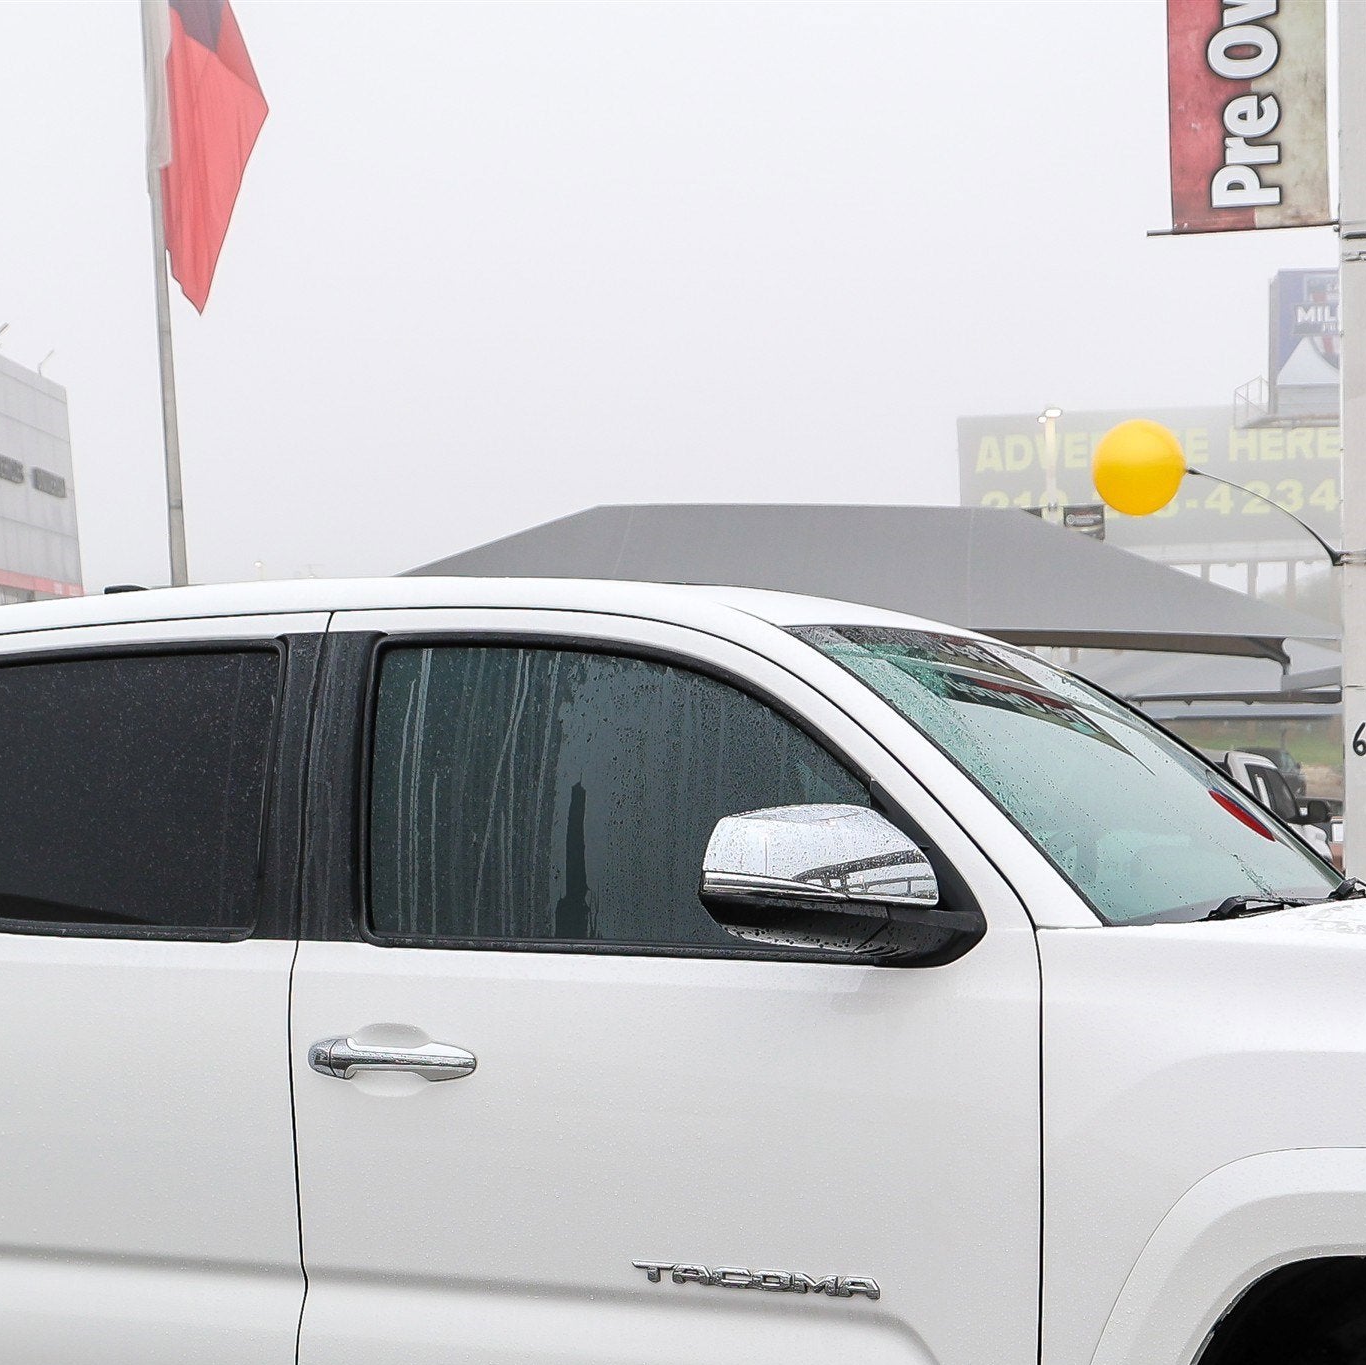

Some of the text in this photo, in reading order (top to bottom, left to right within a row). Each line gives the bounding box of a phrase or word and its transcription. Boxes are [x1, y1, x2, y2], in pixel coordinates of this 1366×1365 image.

[1211, 93, 1281, 208] Pre
[1228, 425, 1341, 462] HERE
[632, 1259, 881, 1300] TACOMA
